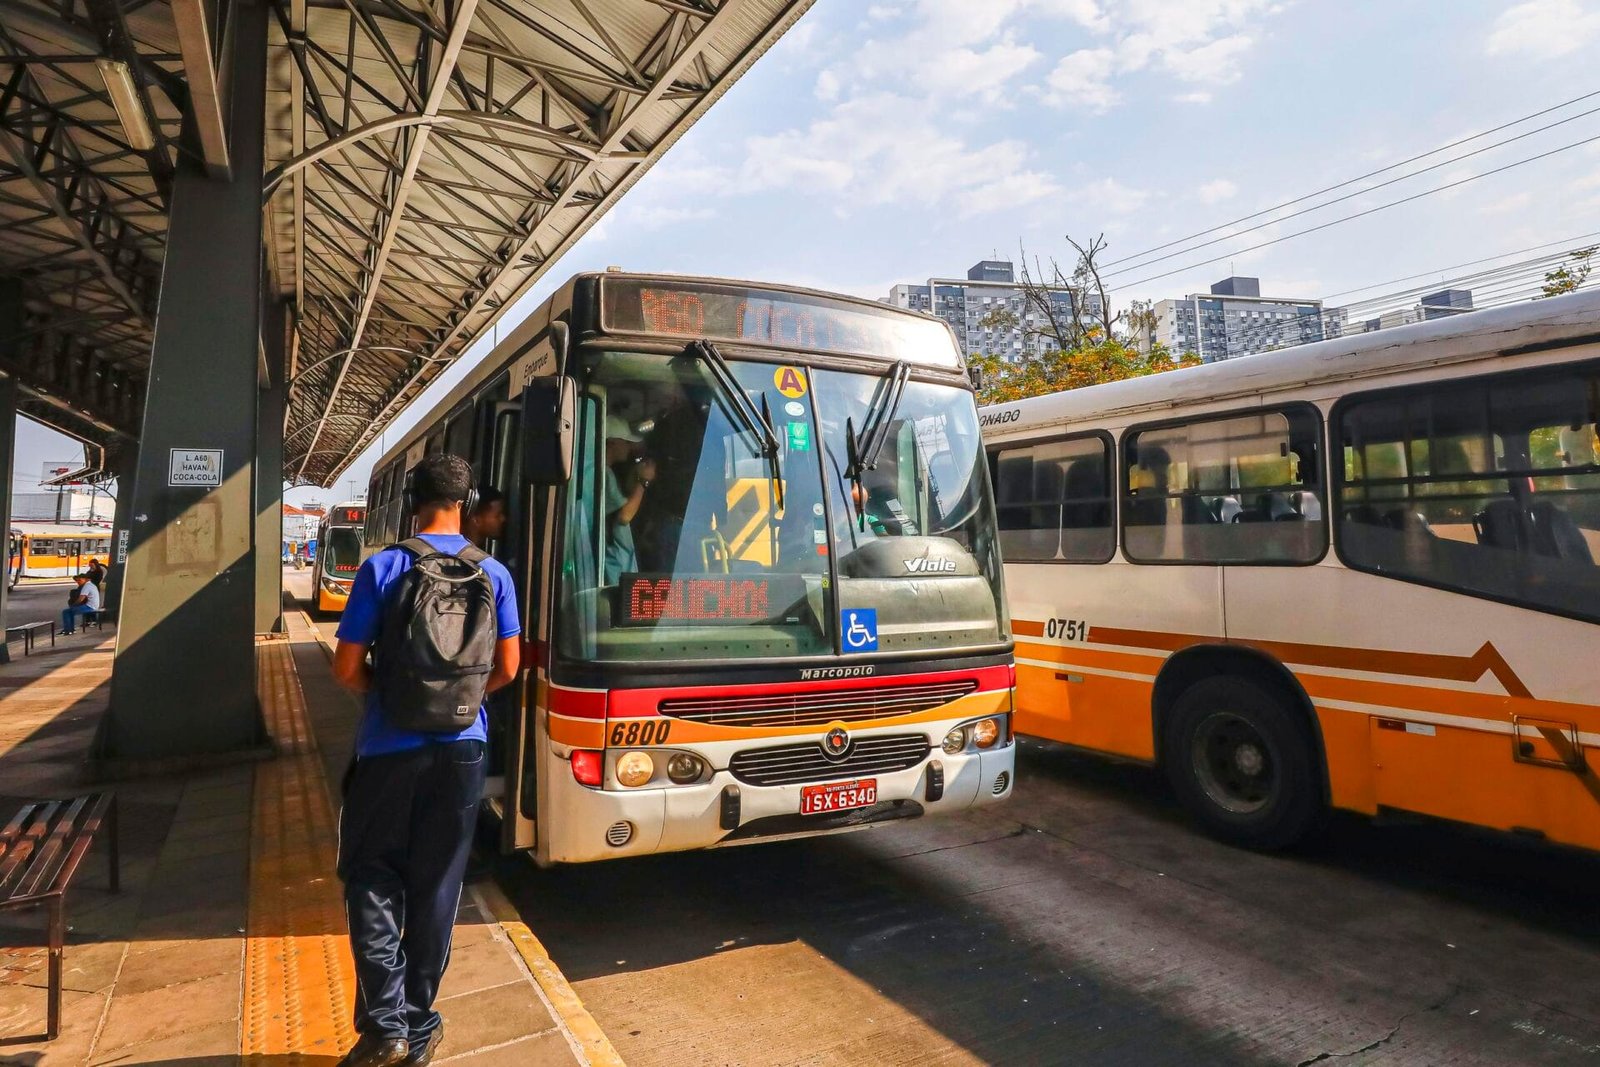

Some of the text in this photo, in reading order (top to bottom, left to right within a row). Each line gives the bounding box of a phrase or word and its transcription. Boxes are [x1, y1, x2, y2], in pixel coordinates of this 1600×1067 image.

[780, 367, 804, 393] A
[173, 473, 217, 481] COCA-COLA
[902, 557, 956, 572] Viale
[1047, 617, 1085, 642] 0751
[801, 666, 873, 680] Marcopolo
[610, 719, 671, 746] 6800
